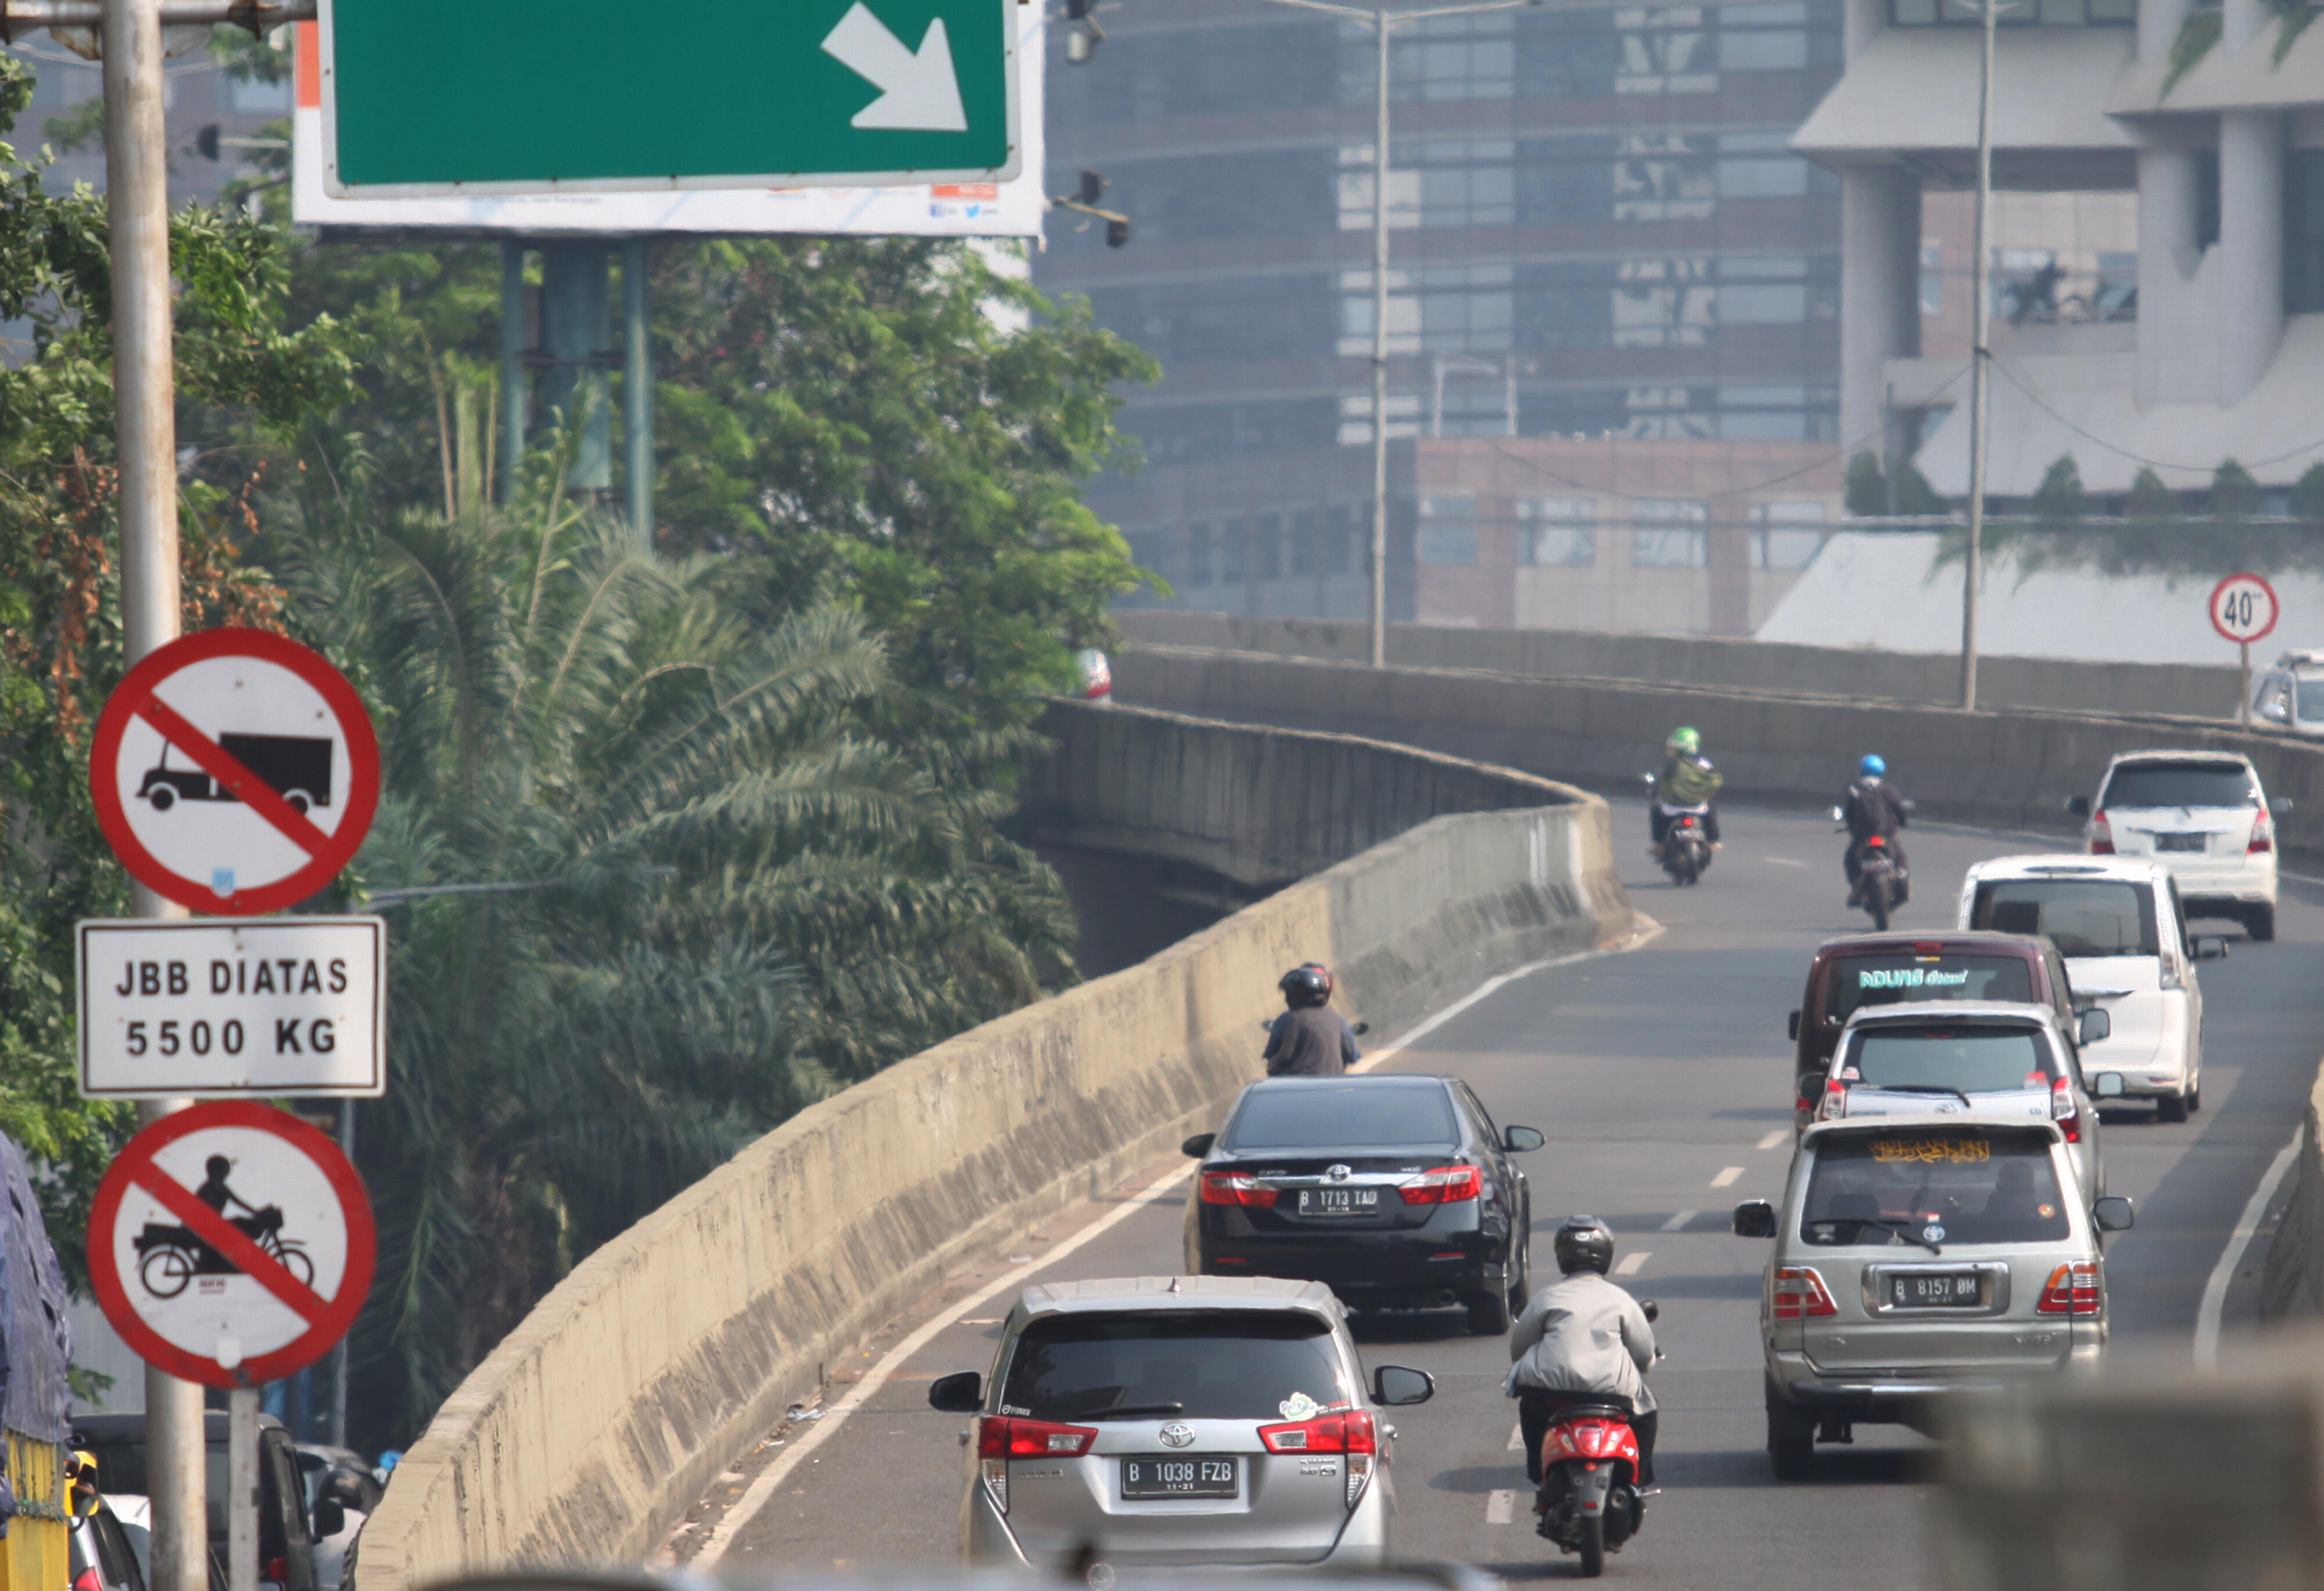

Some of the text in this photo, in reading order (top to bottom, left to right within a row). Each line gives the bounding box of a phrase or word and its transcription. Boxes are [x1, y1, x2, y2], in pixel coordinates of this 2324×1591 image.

[2224, 591, 2252, 627] 40
[116, 958, 348, 997] JBB DIATAS
[126, 1018, 335, 1057] 5500 KG
[1301, 1191, 1308, 1205] B
[1320, 1191, 1349, 1206] 1713
[1896, 1280, 1905, 1296] B
[1918, 1278, 1950, 1295] 8157
[1129, 1462, 1232, 1482] B 1038 FZB
